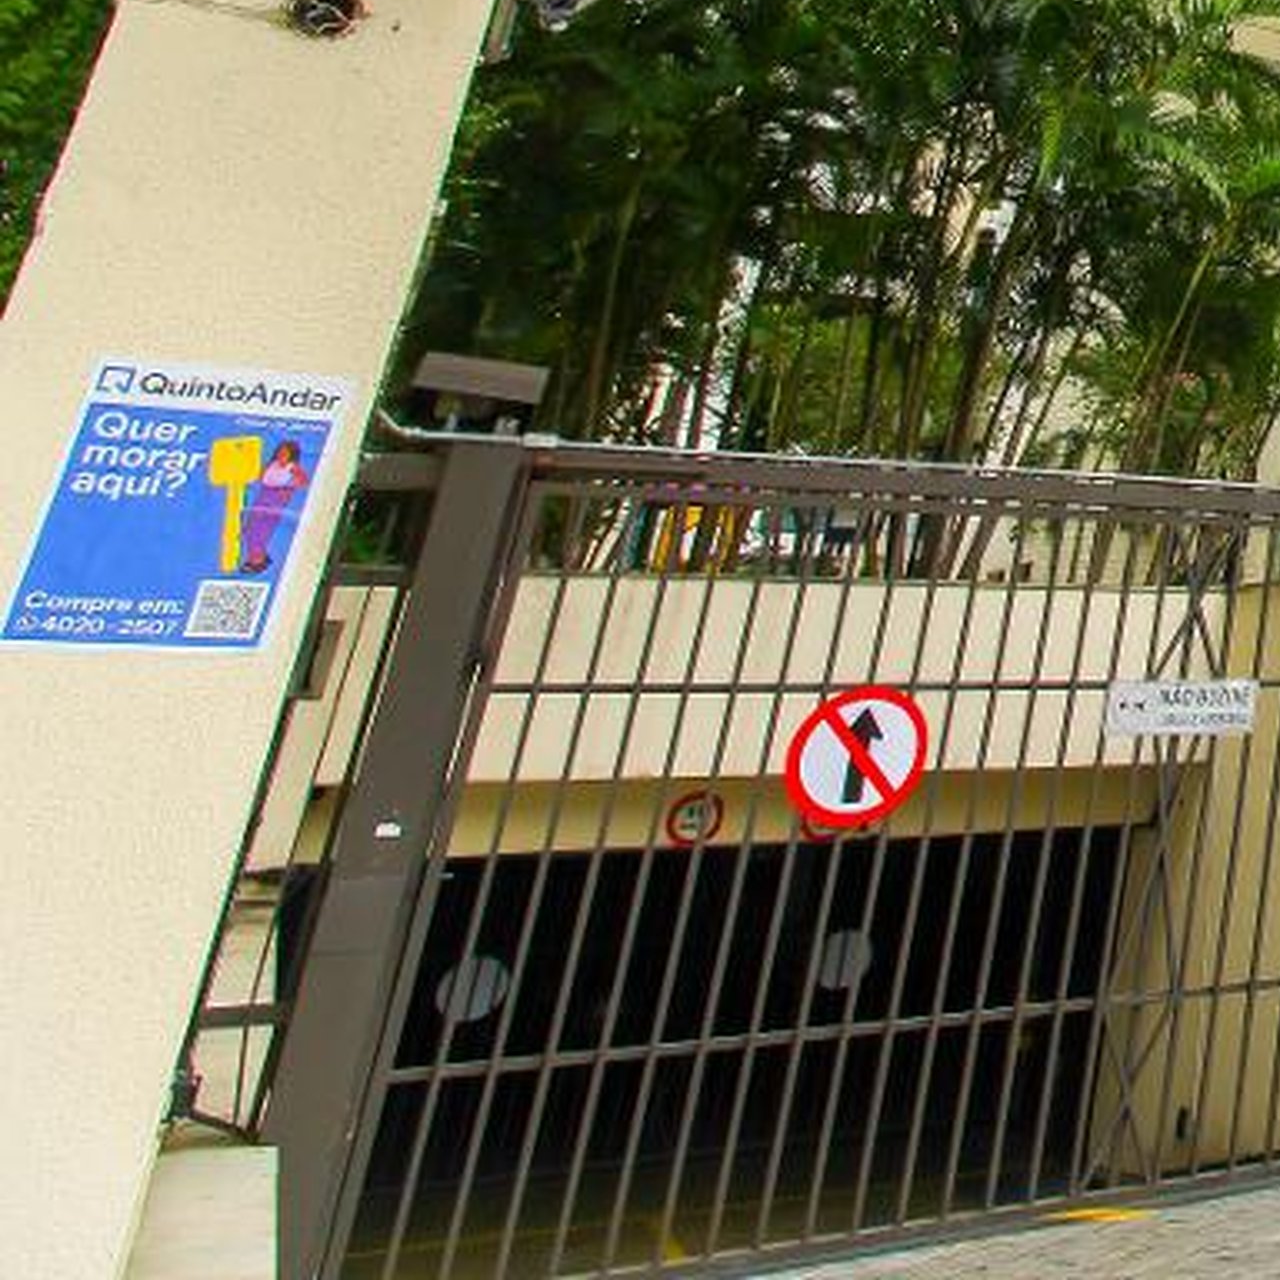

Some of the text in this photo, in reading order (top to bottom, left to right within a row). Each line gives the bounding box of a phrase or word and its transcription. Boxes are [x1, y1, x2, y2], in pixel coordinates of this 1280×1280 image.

[139, 372, 341, 412] QuintoAndar
[94, 411, 199, 443] Quer
[82, 445, 208, 472] morar
[69, 468, 189, 502] aqui?
